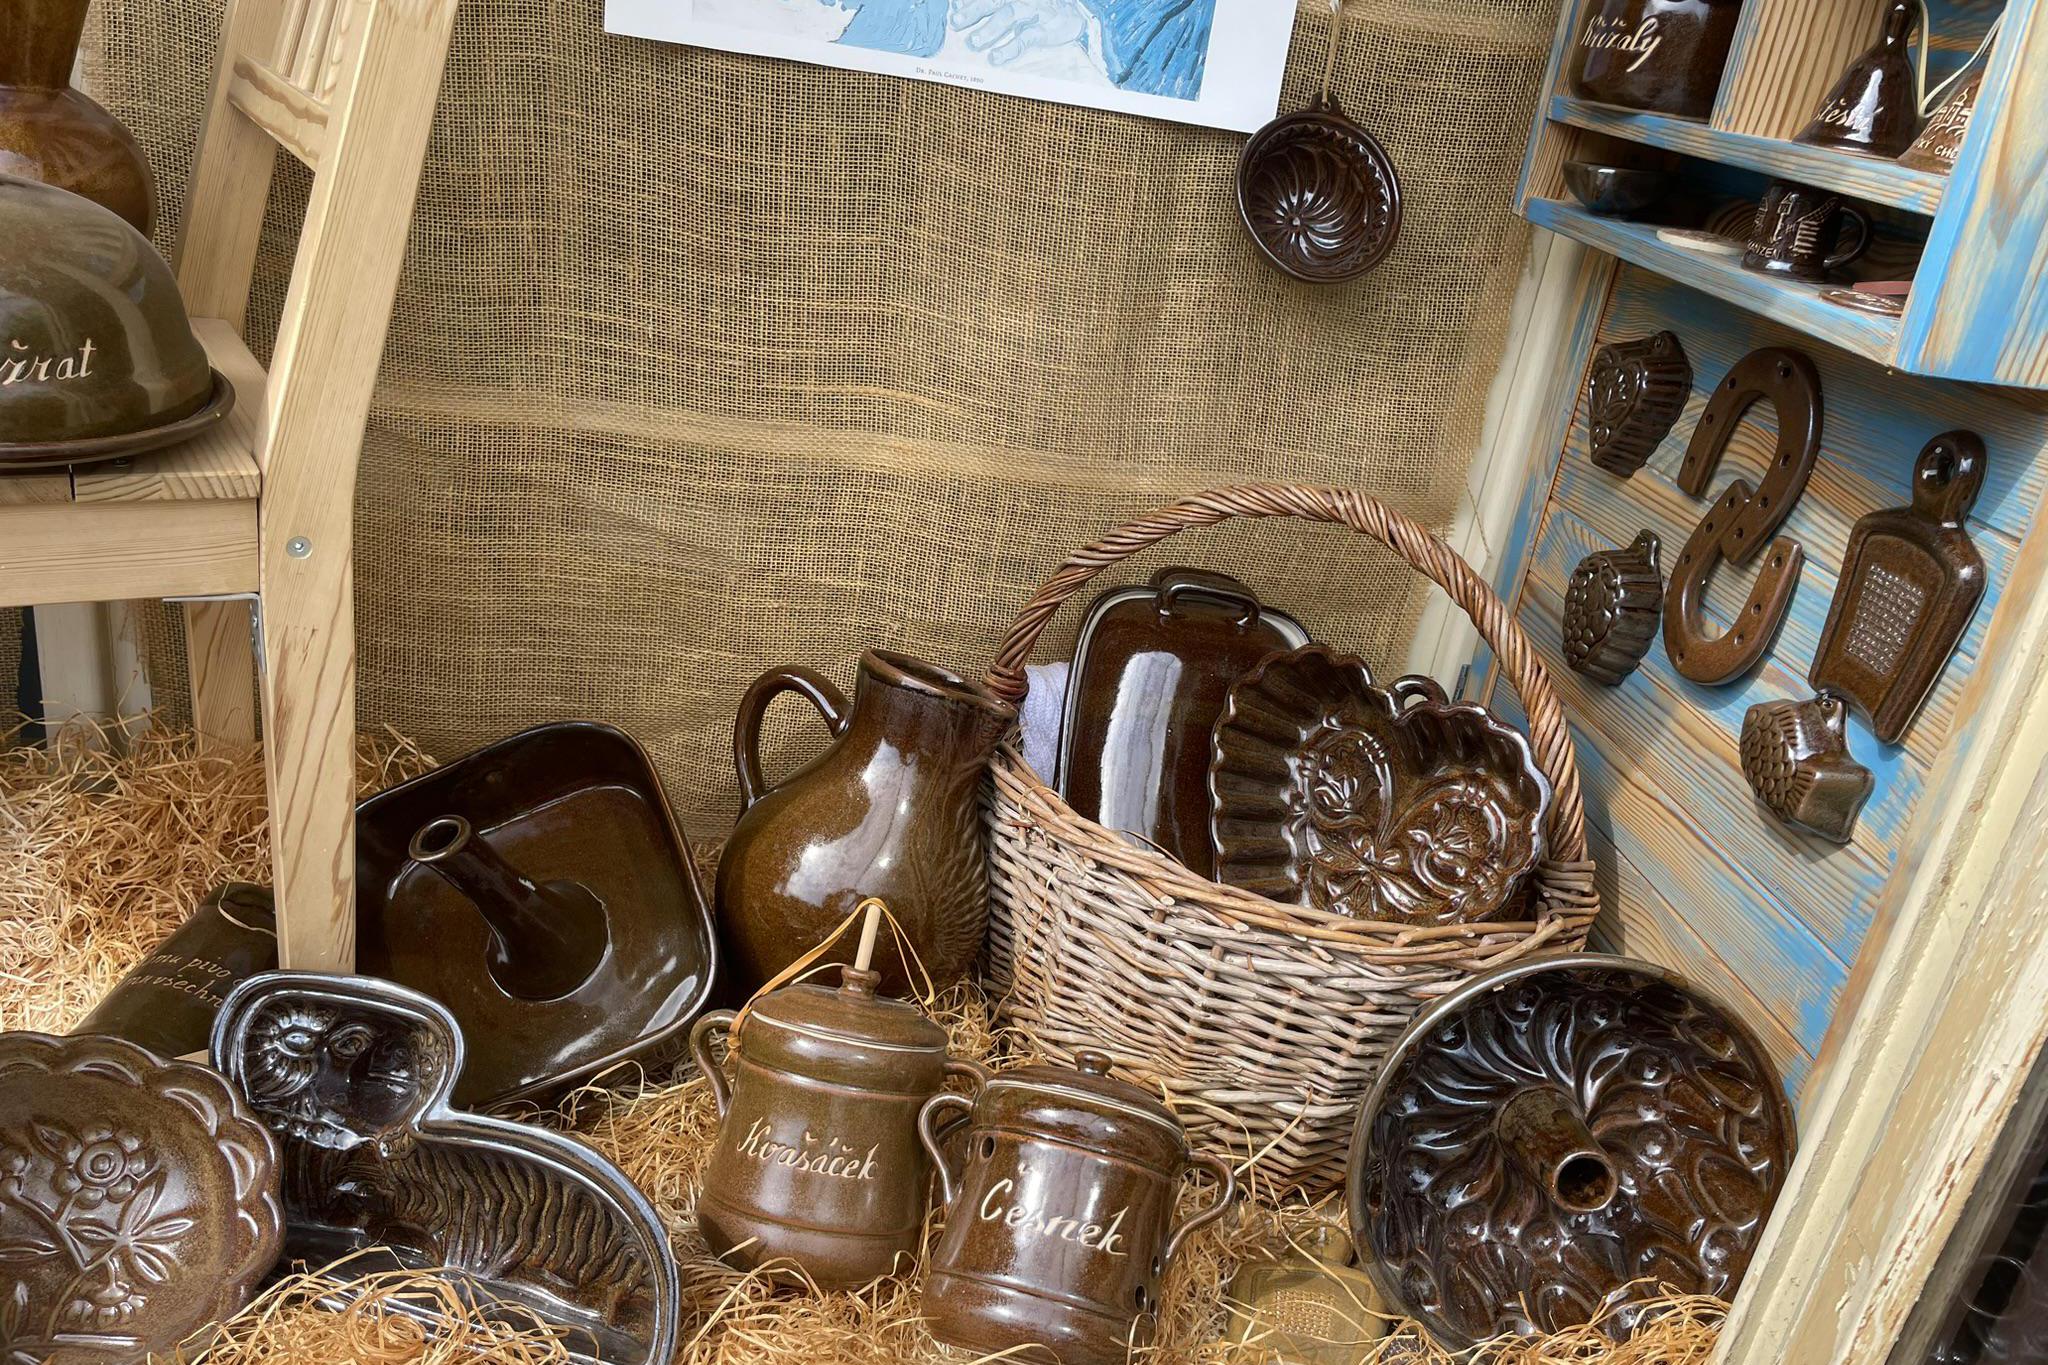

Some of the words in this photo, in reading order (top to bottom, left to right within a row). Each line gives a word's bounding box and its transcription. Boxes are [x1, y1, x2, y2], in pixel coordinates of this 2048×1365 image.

[152, 974, 223, 1008] všechn
[177, 956, 231, 978] pivo
[736, 1116, 880, 1180] Kvašáček
[980, 1161, 1129, 1256] Česnek
